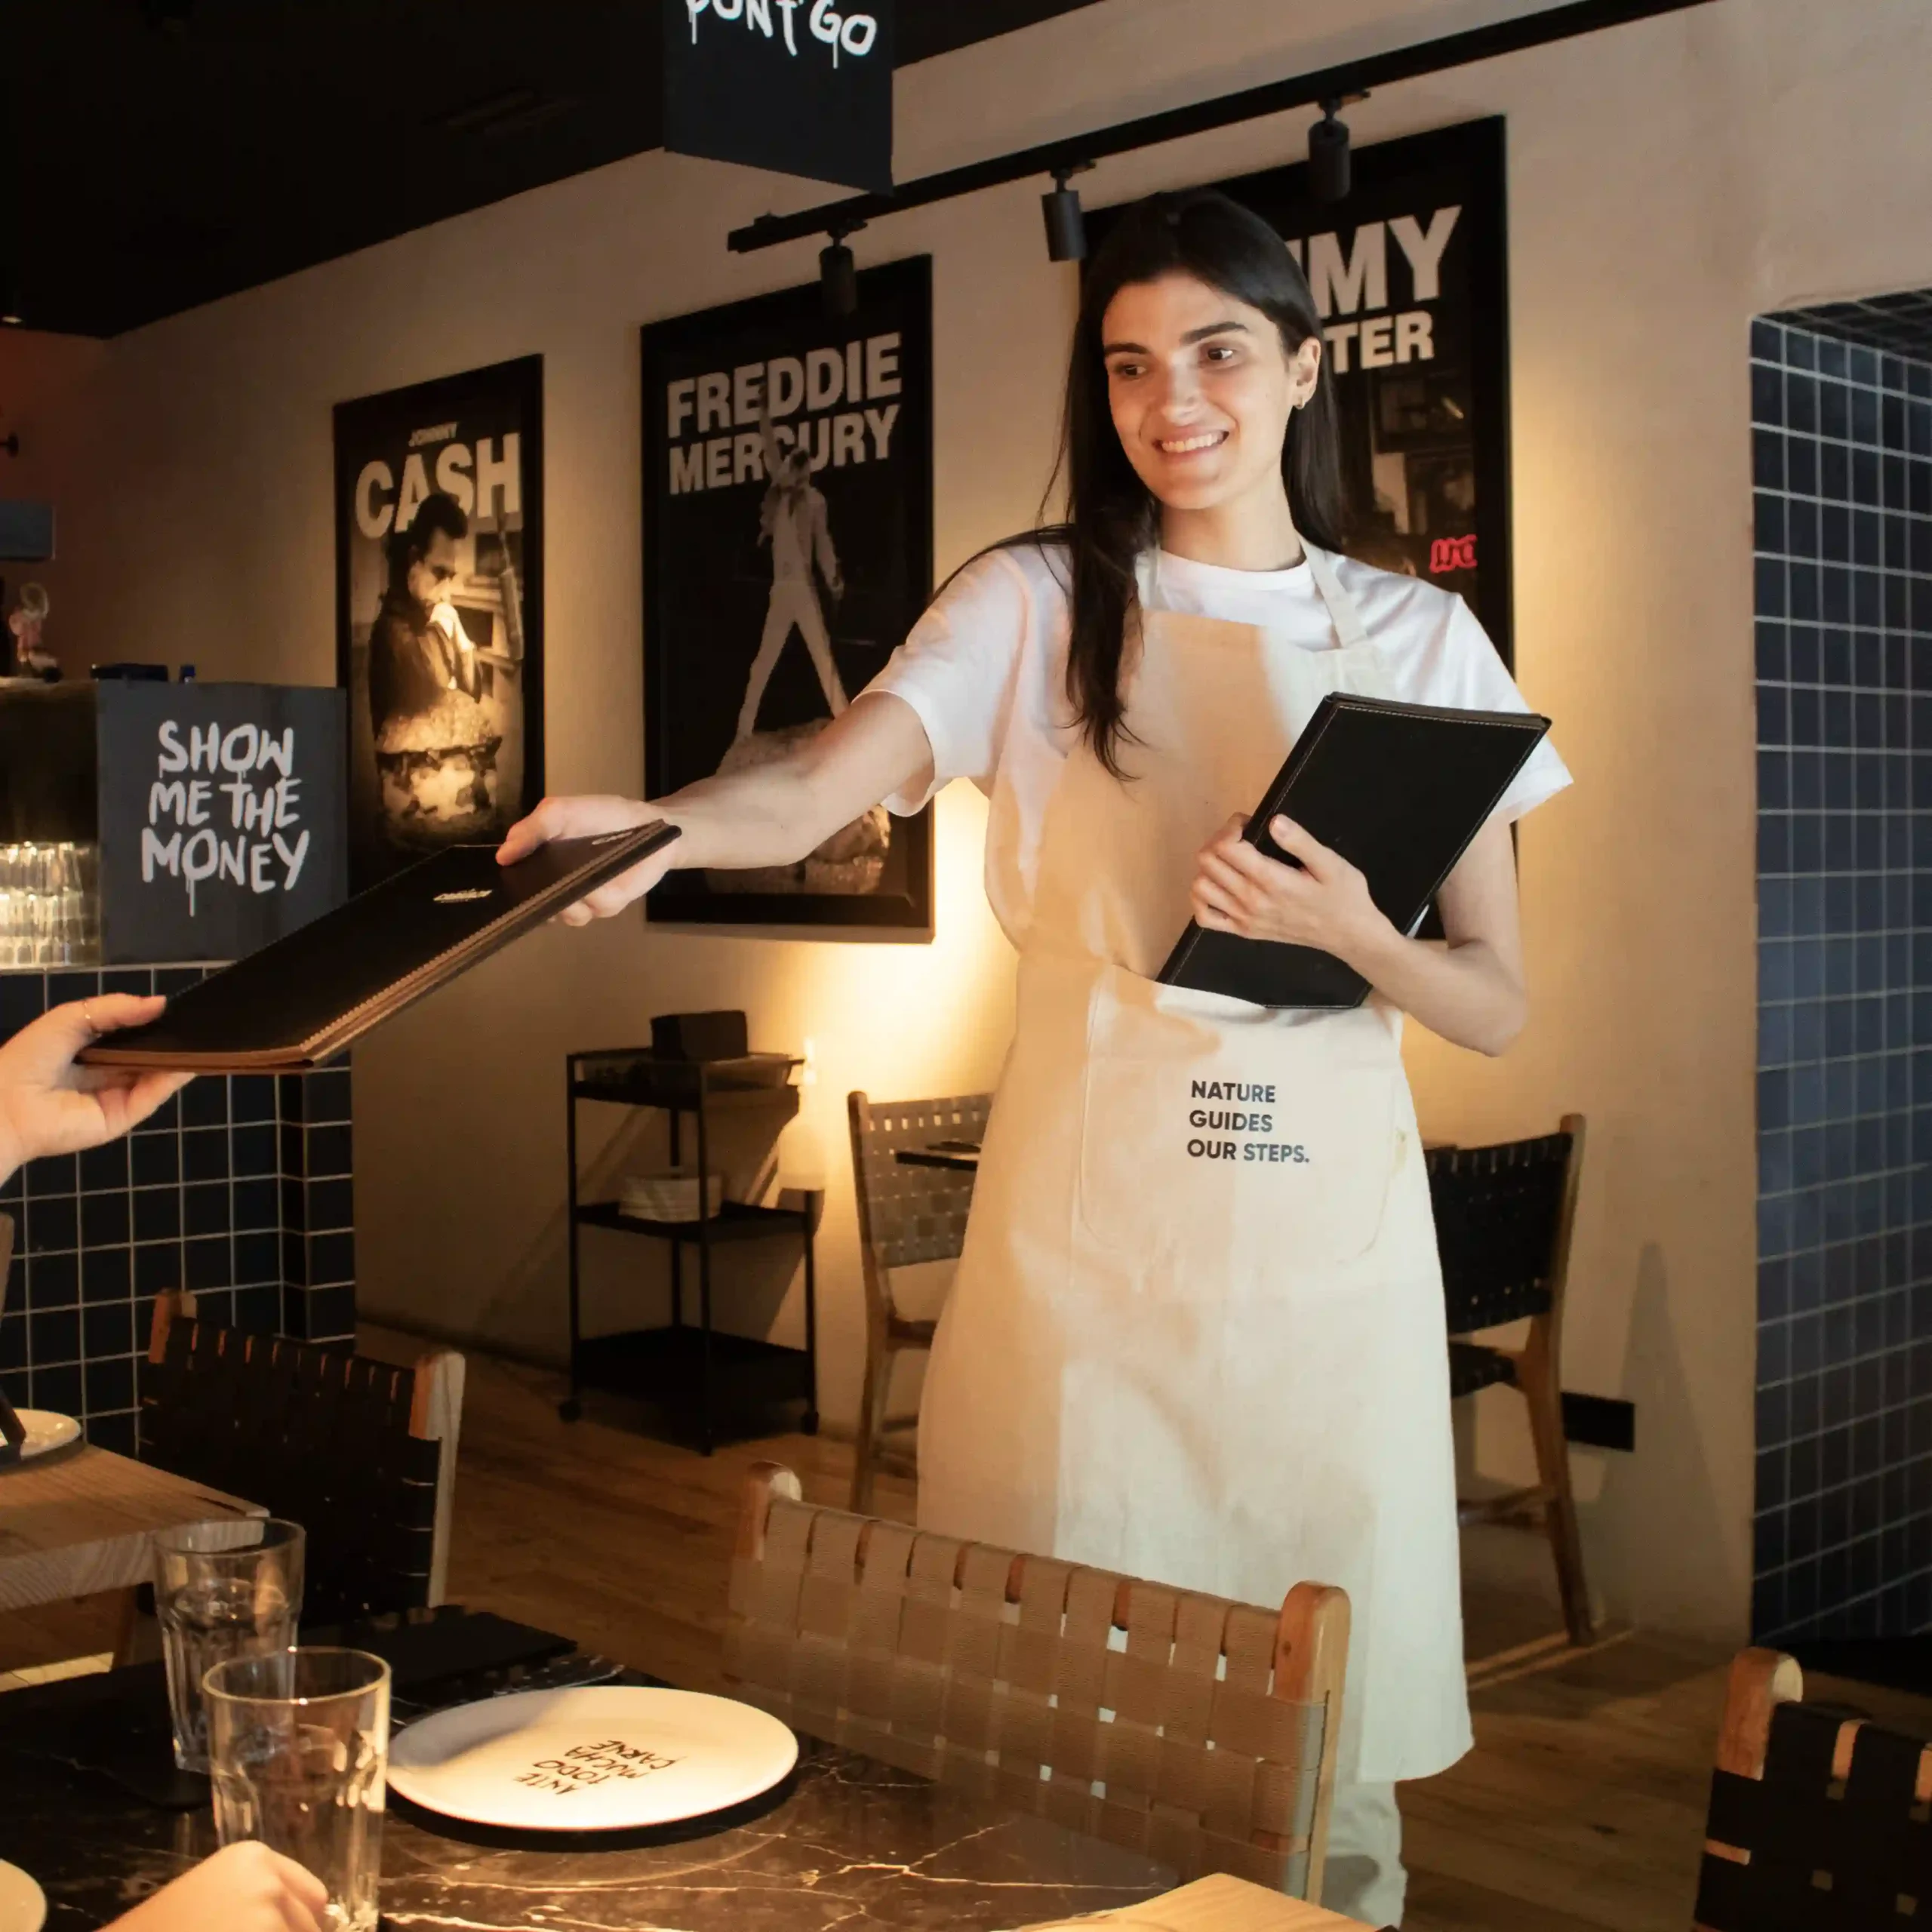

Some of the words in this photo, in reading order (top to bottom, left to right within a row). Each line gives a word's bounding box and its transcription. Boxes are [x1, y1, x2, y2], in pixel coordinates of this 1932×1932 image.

[810, 0, 877, 69] GO
[1285, 204, 1463, 320] MY
[667, 331, 902, 439] FREDDIE
[355, 432, 521, 540] CASH
[158, 719, 294, 779] SHOW
[149, 780, 213, 826] ME
[219, 777, 302, 838] THE
[141, 826, 310, 895] MONEY
[1189, 1109, 1273, 1133] GUIDES
[1191, 1080, 1276, 1103] NATURE
[1186, 1138, 1238, 1160] OUR
[1243, 1143, 1311, 1163] STEPS.
[533, 1759, 610, 1785] TODO
